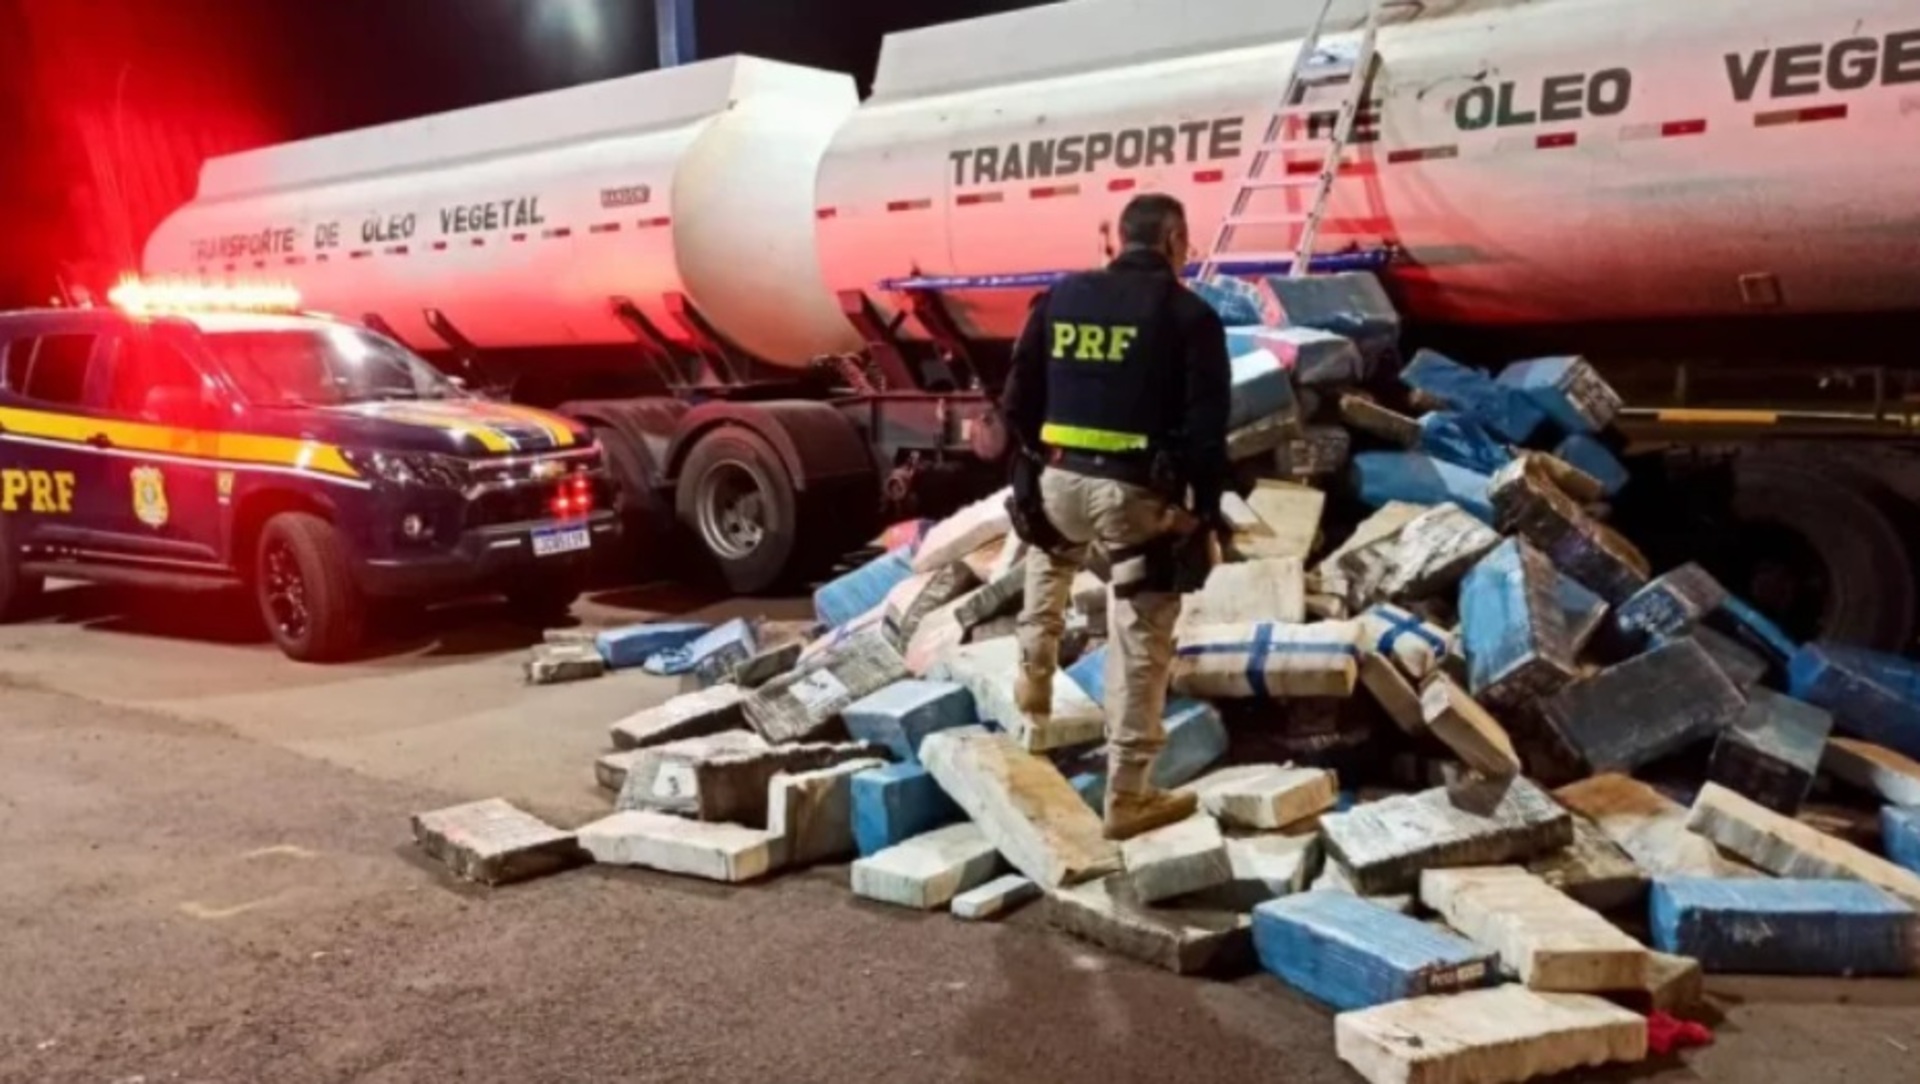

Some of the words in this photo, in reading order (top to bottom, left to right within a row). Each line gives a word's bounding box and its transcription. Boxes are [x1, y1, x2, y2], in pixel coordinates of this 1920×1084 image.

[949, 117, 1243, 186] TRANSPORTE
[1724, 29, 1920, 102] VEGE
[314, 222, 339, 249] DE
[440, 197, 544, 234] VEGETAL
[1052, 323, 1137, 360] PRF
[1, 468, 75, 512] PRF
